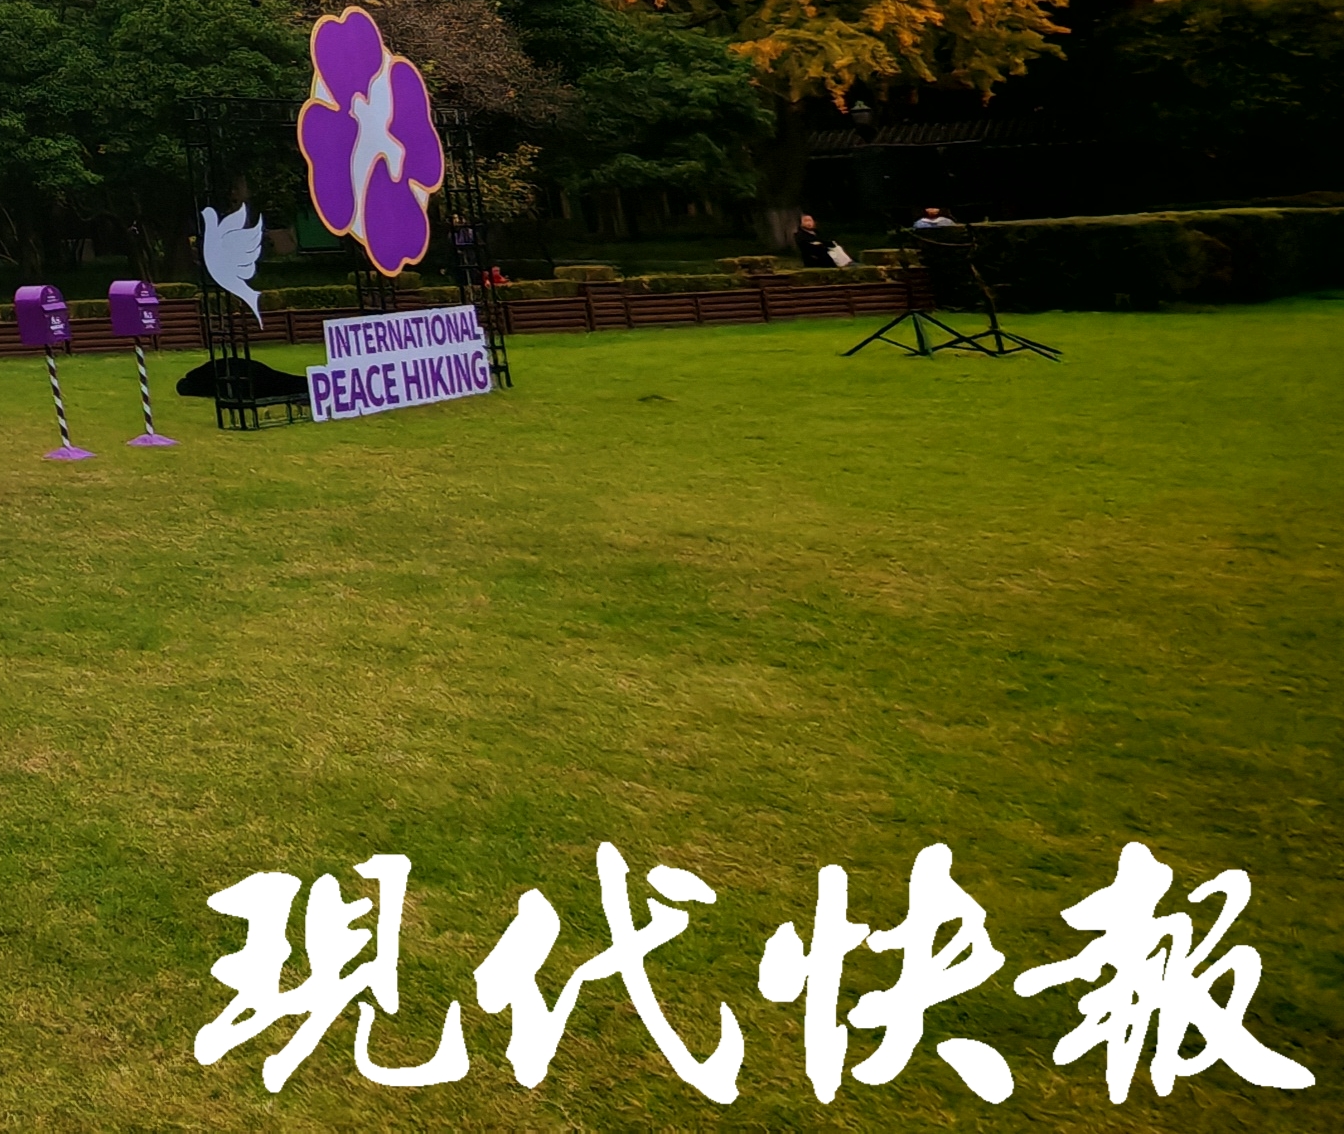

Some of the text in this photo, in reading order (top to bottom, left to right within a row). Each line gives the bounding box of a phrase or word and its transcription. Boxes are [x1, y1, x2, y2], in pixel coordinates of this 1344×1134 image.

[328, 312, 481, 359] INTERNATIONAL
[312, 350, 488, 416] PEACE HIKING
